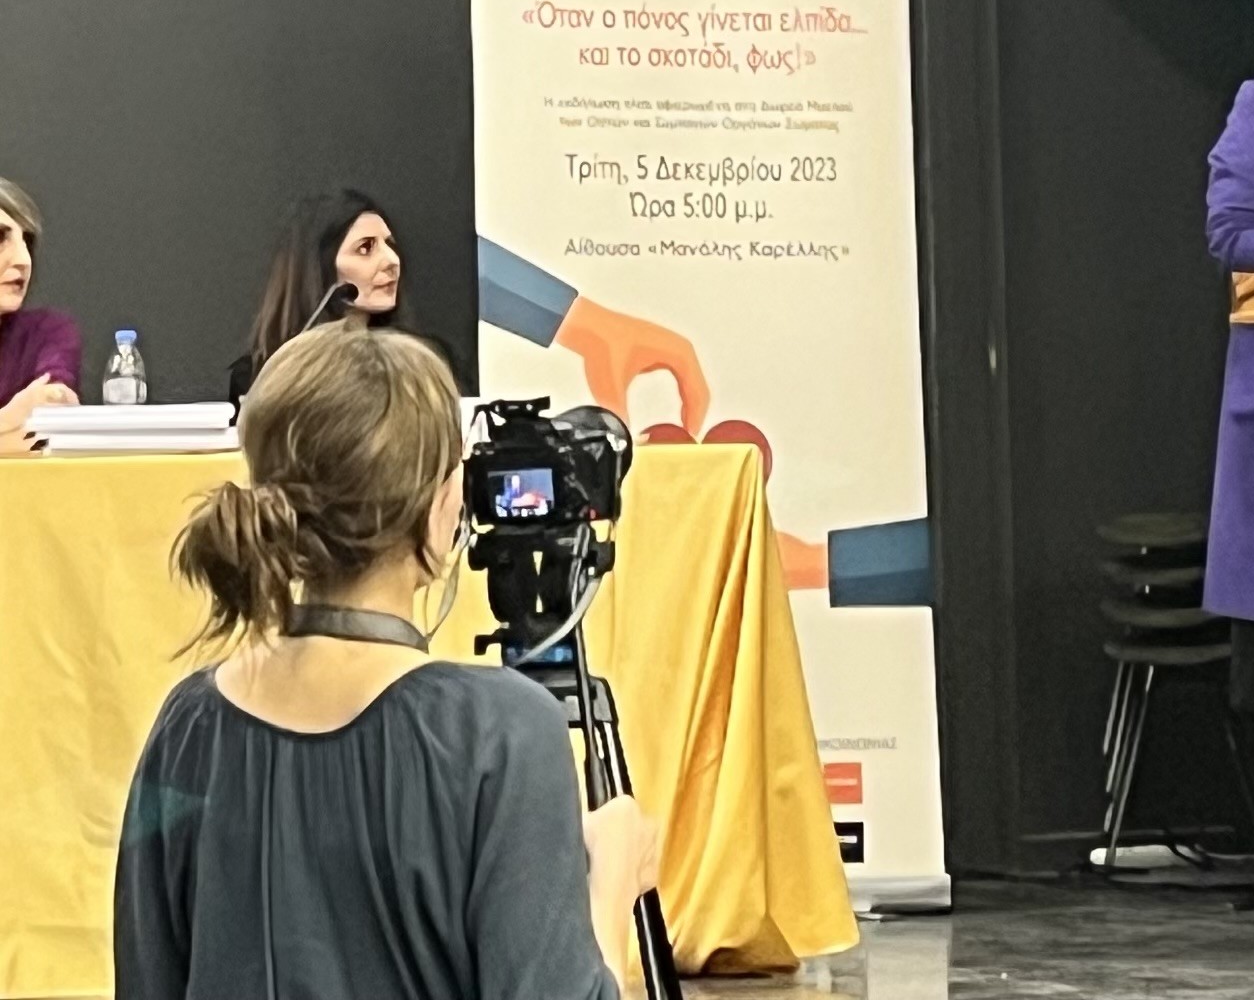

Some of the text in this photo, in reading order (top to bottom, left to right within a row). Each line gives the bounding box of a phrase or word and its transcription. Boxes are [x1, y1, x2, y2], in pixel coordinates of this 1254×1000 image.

[602, 9, 616, 29] ο
[623, 1, 690, 38] πόνος
[697, 2, 773, 40] γίνεται
[579, 47, 610, 66] και
[617, 47, 641, 67] το
[648, 41, 740, 74] σκοτάδι,
[564, 153, 838, 187] Τρίτη, 5 Δεκεμβρίου 2023
[683, 192, 727, 219] 5:00
[735, 199, 774, 224] μ.μ.
[564, 237, 641, 257] Αίθουσα
